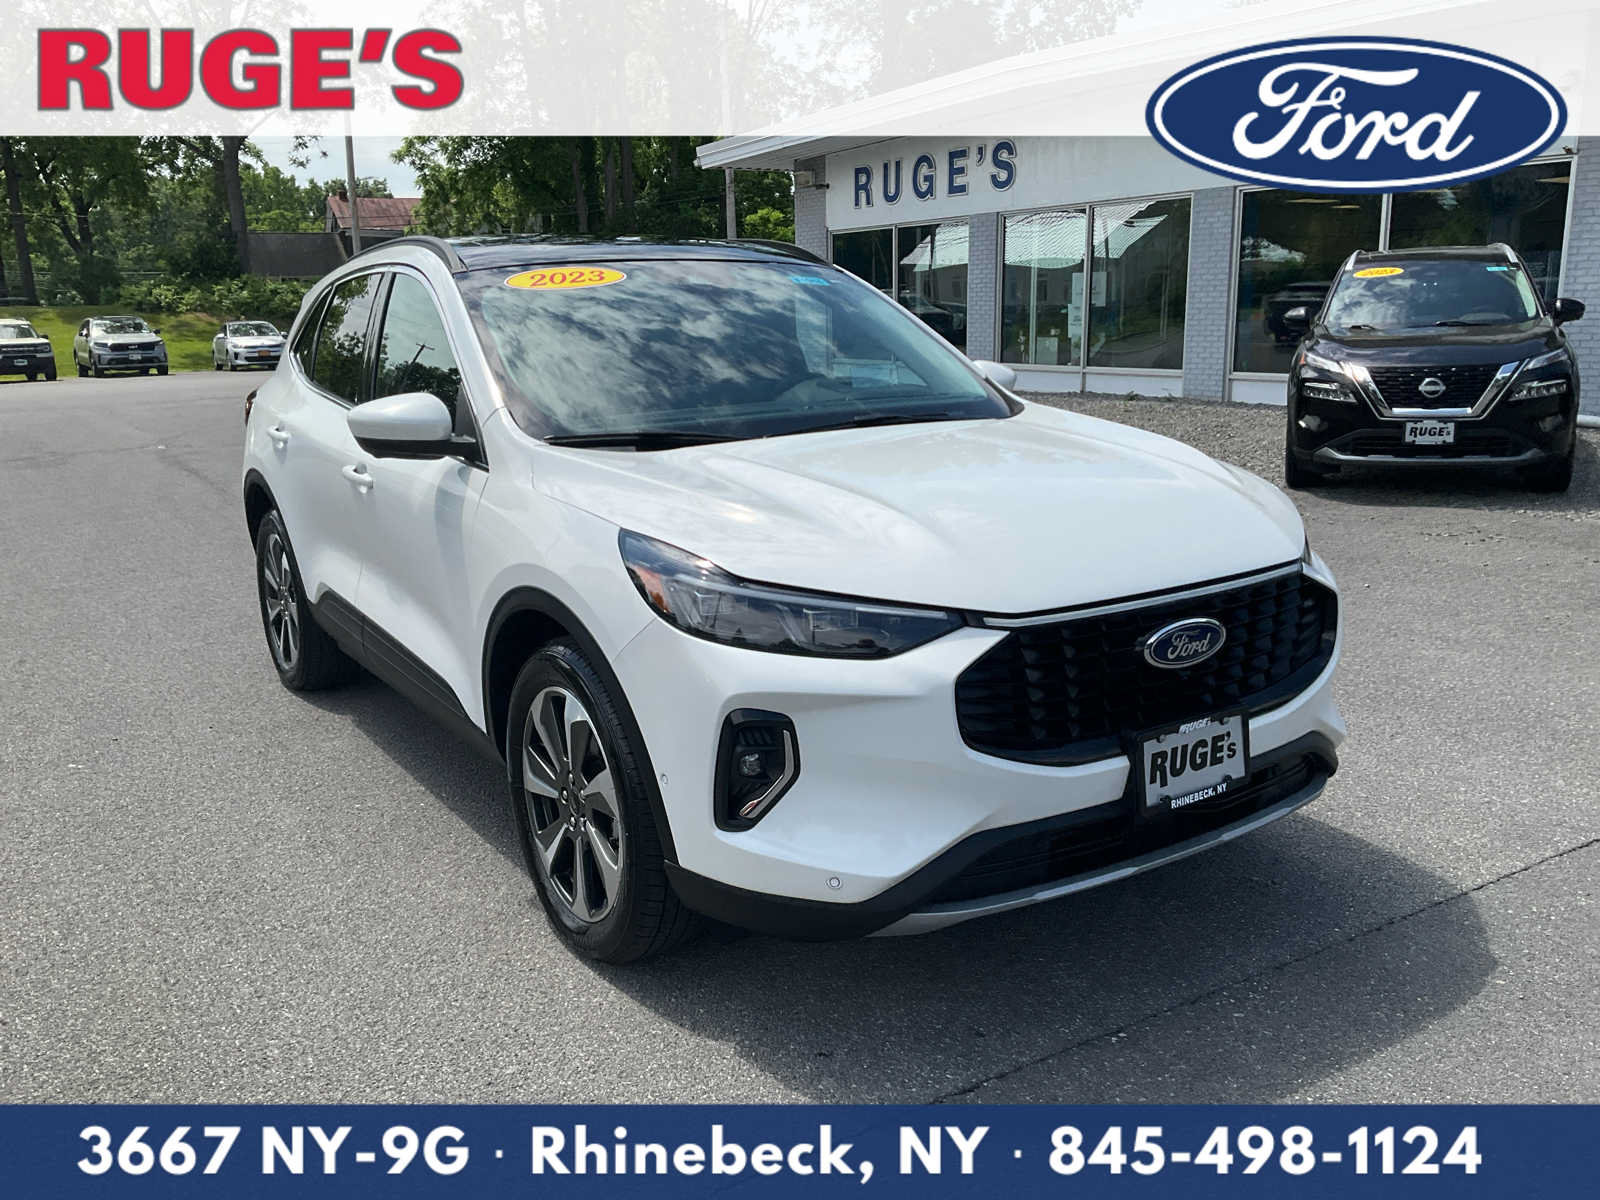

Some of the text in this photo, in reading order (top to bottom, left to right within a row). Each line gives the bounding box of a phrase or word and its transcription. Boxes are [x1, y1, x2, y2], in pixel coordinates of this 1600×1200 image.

[853, 139, 1017, 209] RUGE'S
[530, 269, 606, 288] 2023
[1167, 630, 1210, 660] Ford
[1216, 782, 1228, 794] NY
